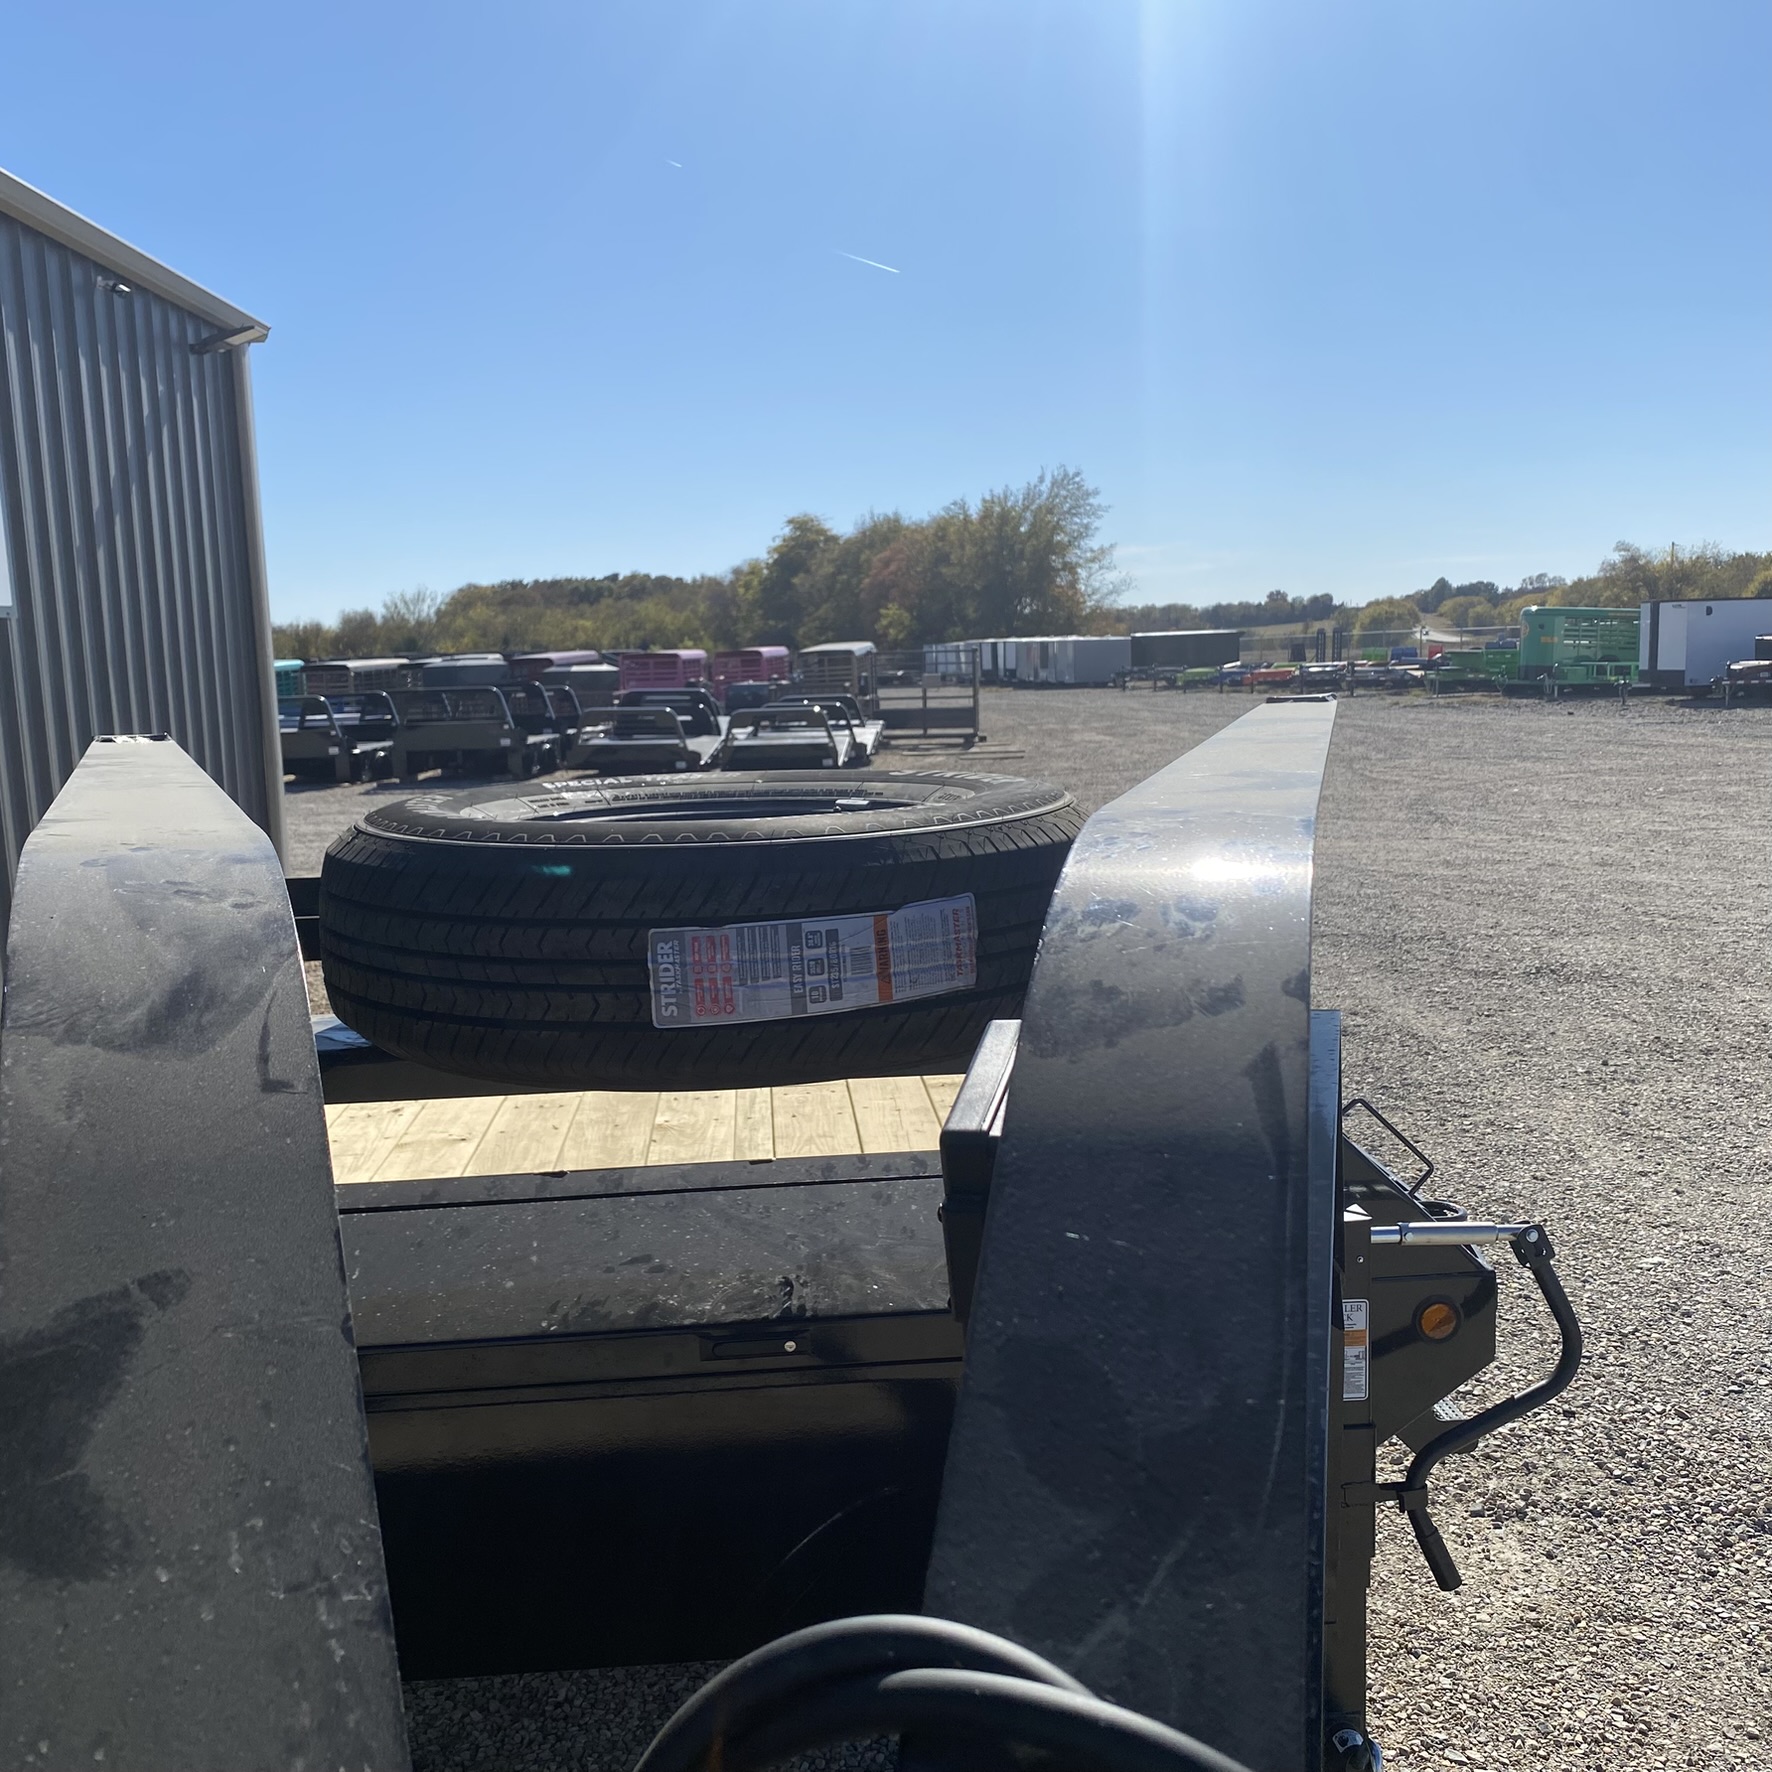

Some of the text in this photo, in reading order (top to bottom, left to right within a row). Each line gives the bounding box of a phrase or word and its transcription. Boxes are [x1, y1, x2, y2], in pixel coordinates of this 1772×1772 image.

[542, 777, 633, 789] SPECIAL
[673, 939, 682, 988] TASKMASTER
[952, 908, 964, 977] TASKMASTER
[656, 940, 678, 1017] STRIDER
[791, 945, 804, 994] EASY RIDER
[811, 990, 819, 999] 10
